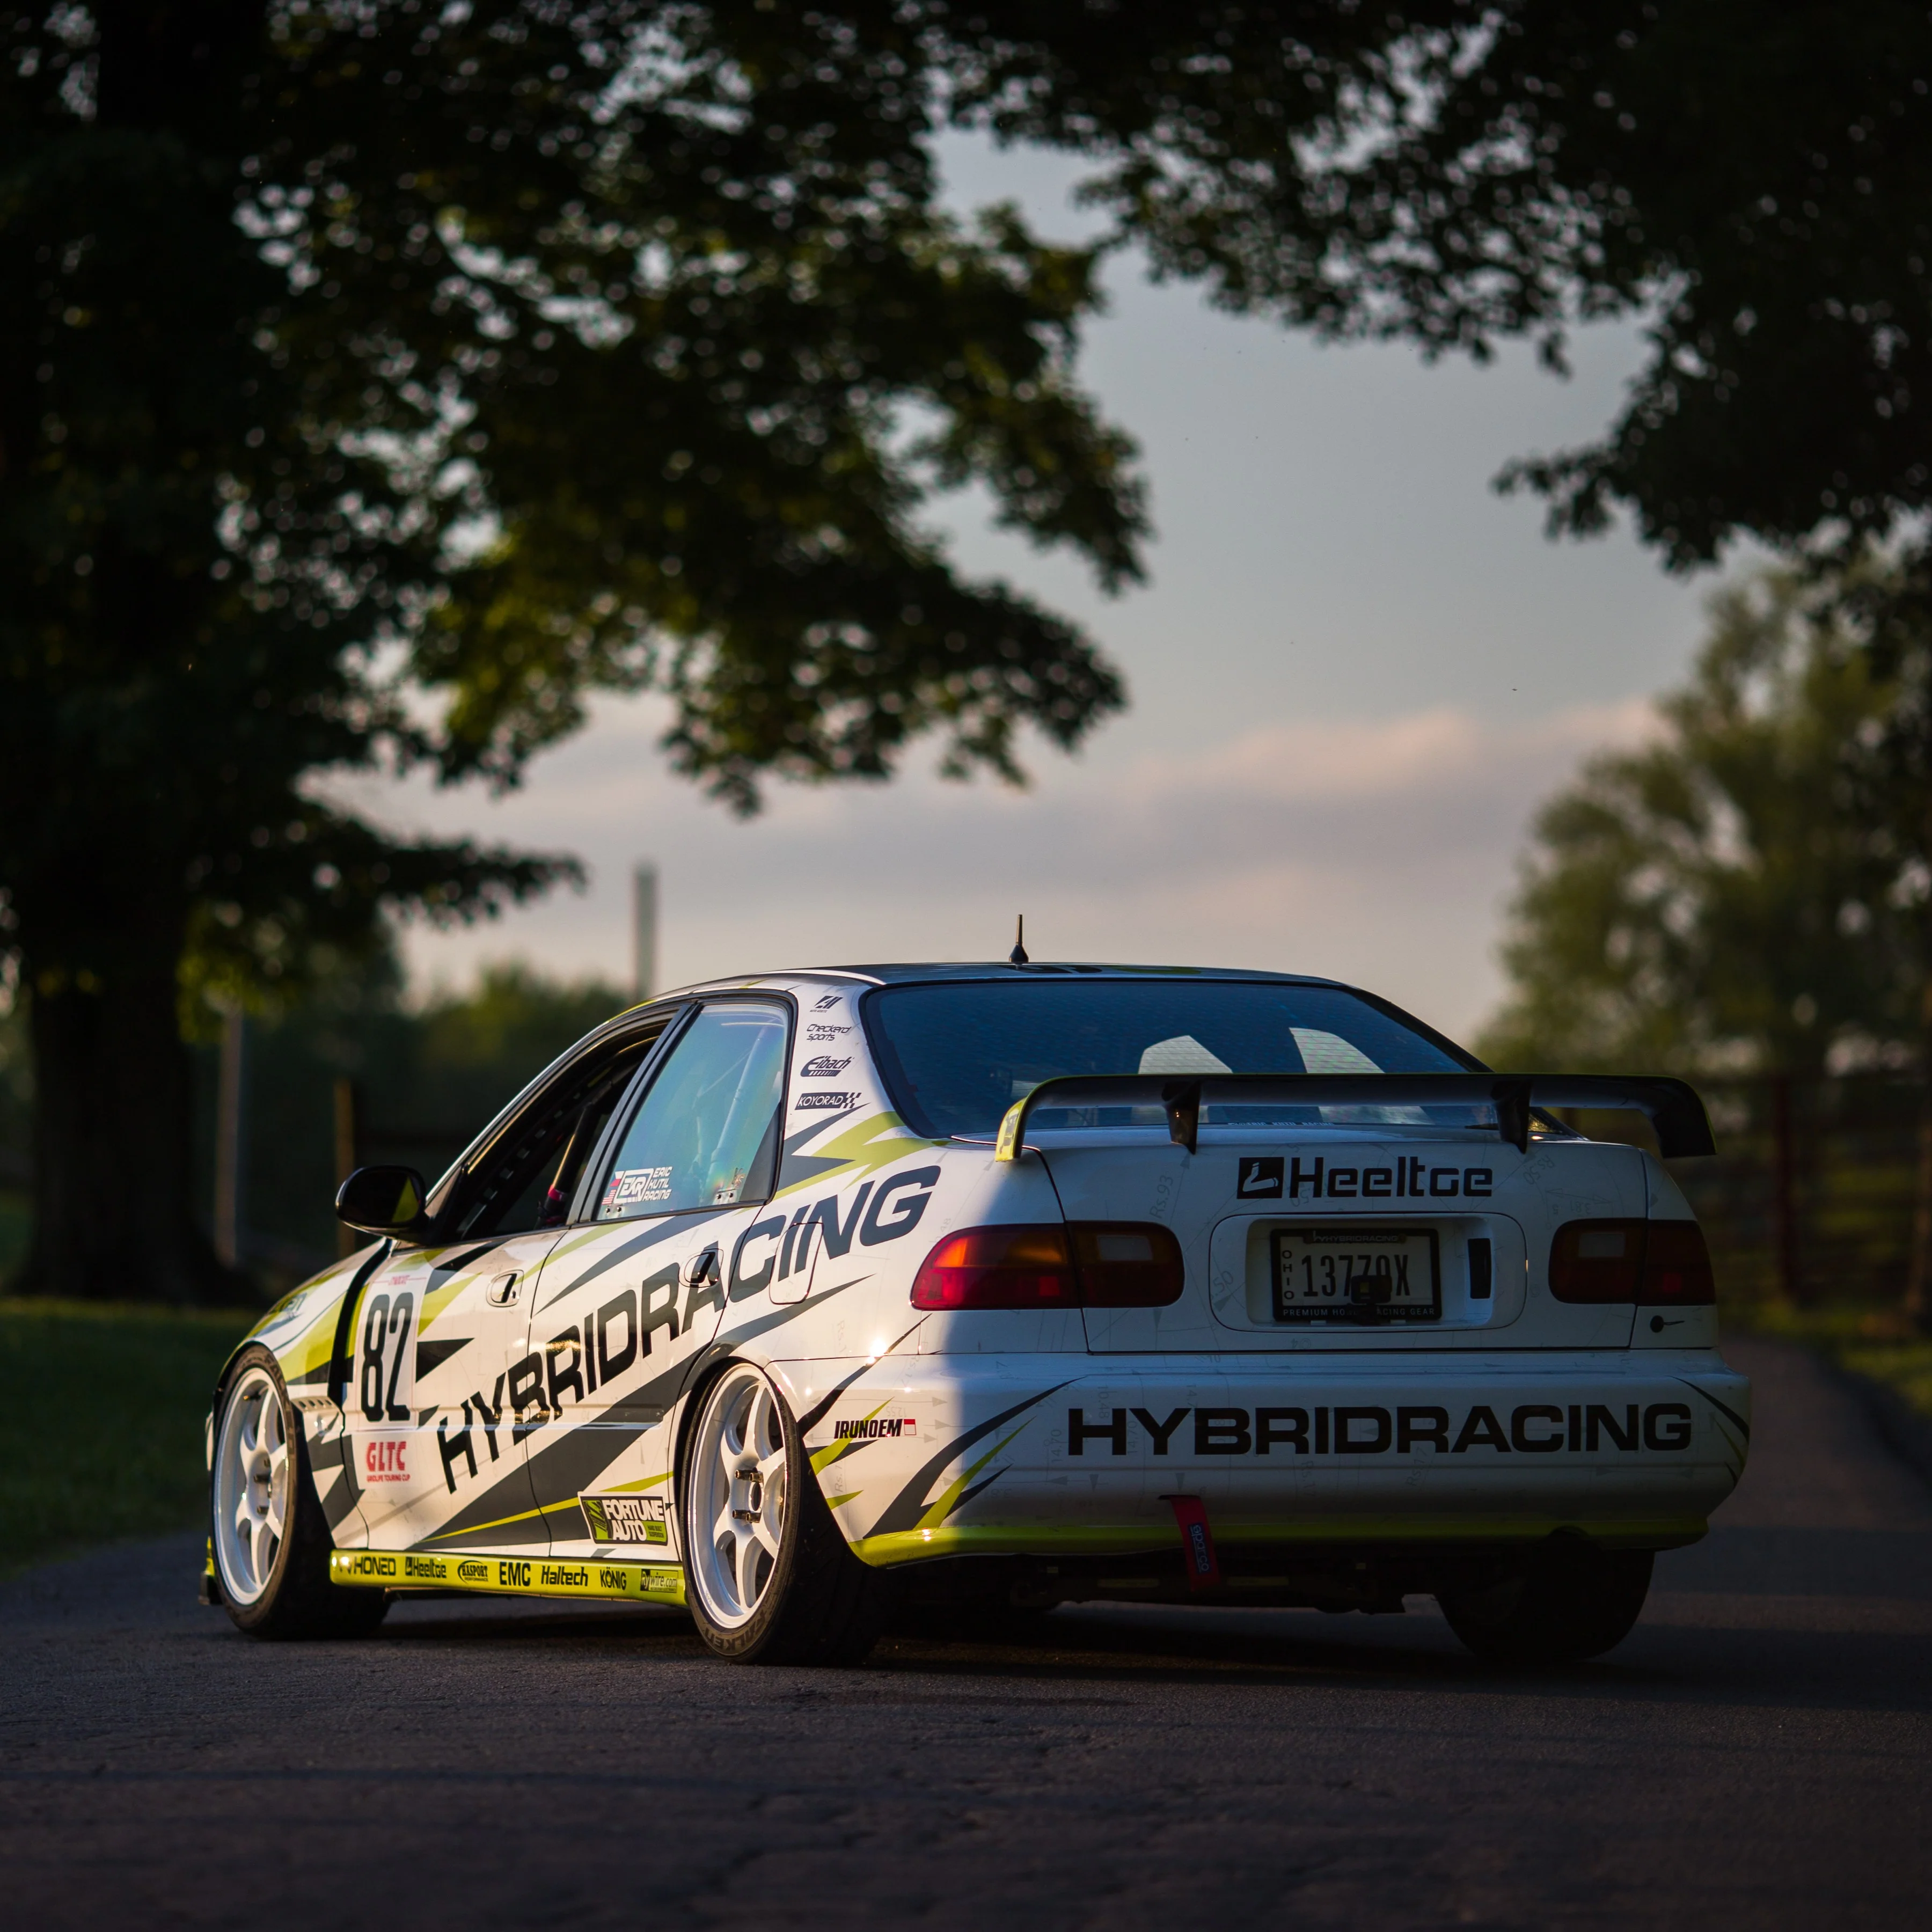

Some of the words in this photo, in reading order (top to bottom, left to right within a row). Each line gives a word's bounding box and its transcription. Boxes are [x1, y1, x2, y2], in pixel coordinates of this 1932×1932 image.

[806, 1056, 853, 1071] Eibach
[797, 1094, 844, 1107] KOYORAD
[653, 1166, 672, 1177] ERIC
[643, 1189, 672, 1201] RACING
[649, 1178, 669, 1190] KUTIL
[1376, 1306, 1406, 1315] ACING
[361, 1292, 414, 1422] 82
[1068, 1403, 1692, 1456] HYBRIDRACING
[366, 1440, 407, 1472] GLTC
[602, 1499, 665, 1521] FORTUNE
[612, 1519, 647, 1541] AUTO
[354, 1556, 396, 1576] HONED
[499, 1561, 531, 1587] EMC
[541, 1565, 589, 1587] Haltech
[599, 1566, 627, 1591] KÖNIG
